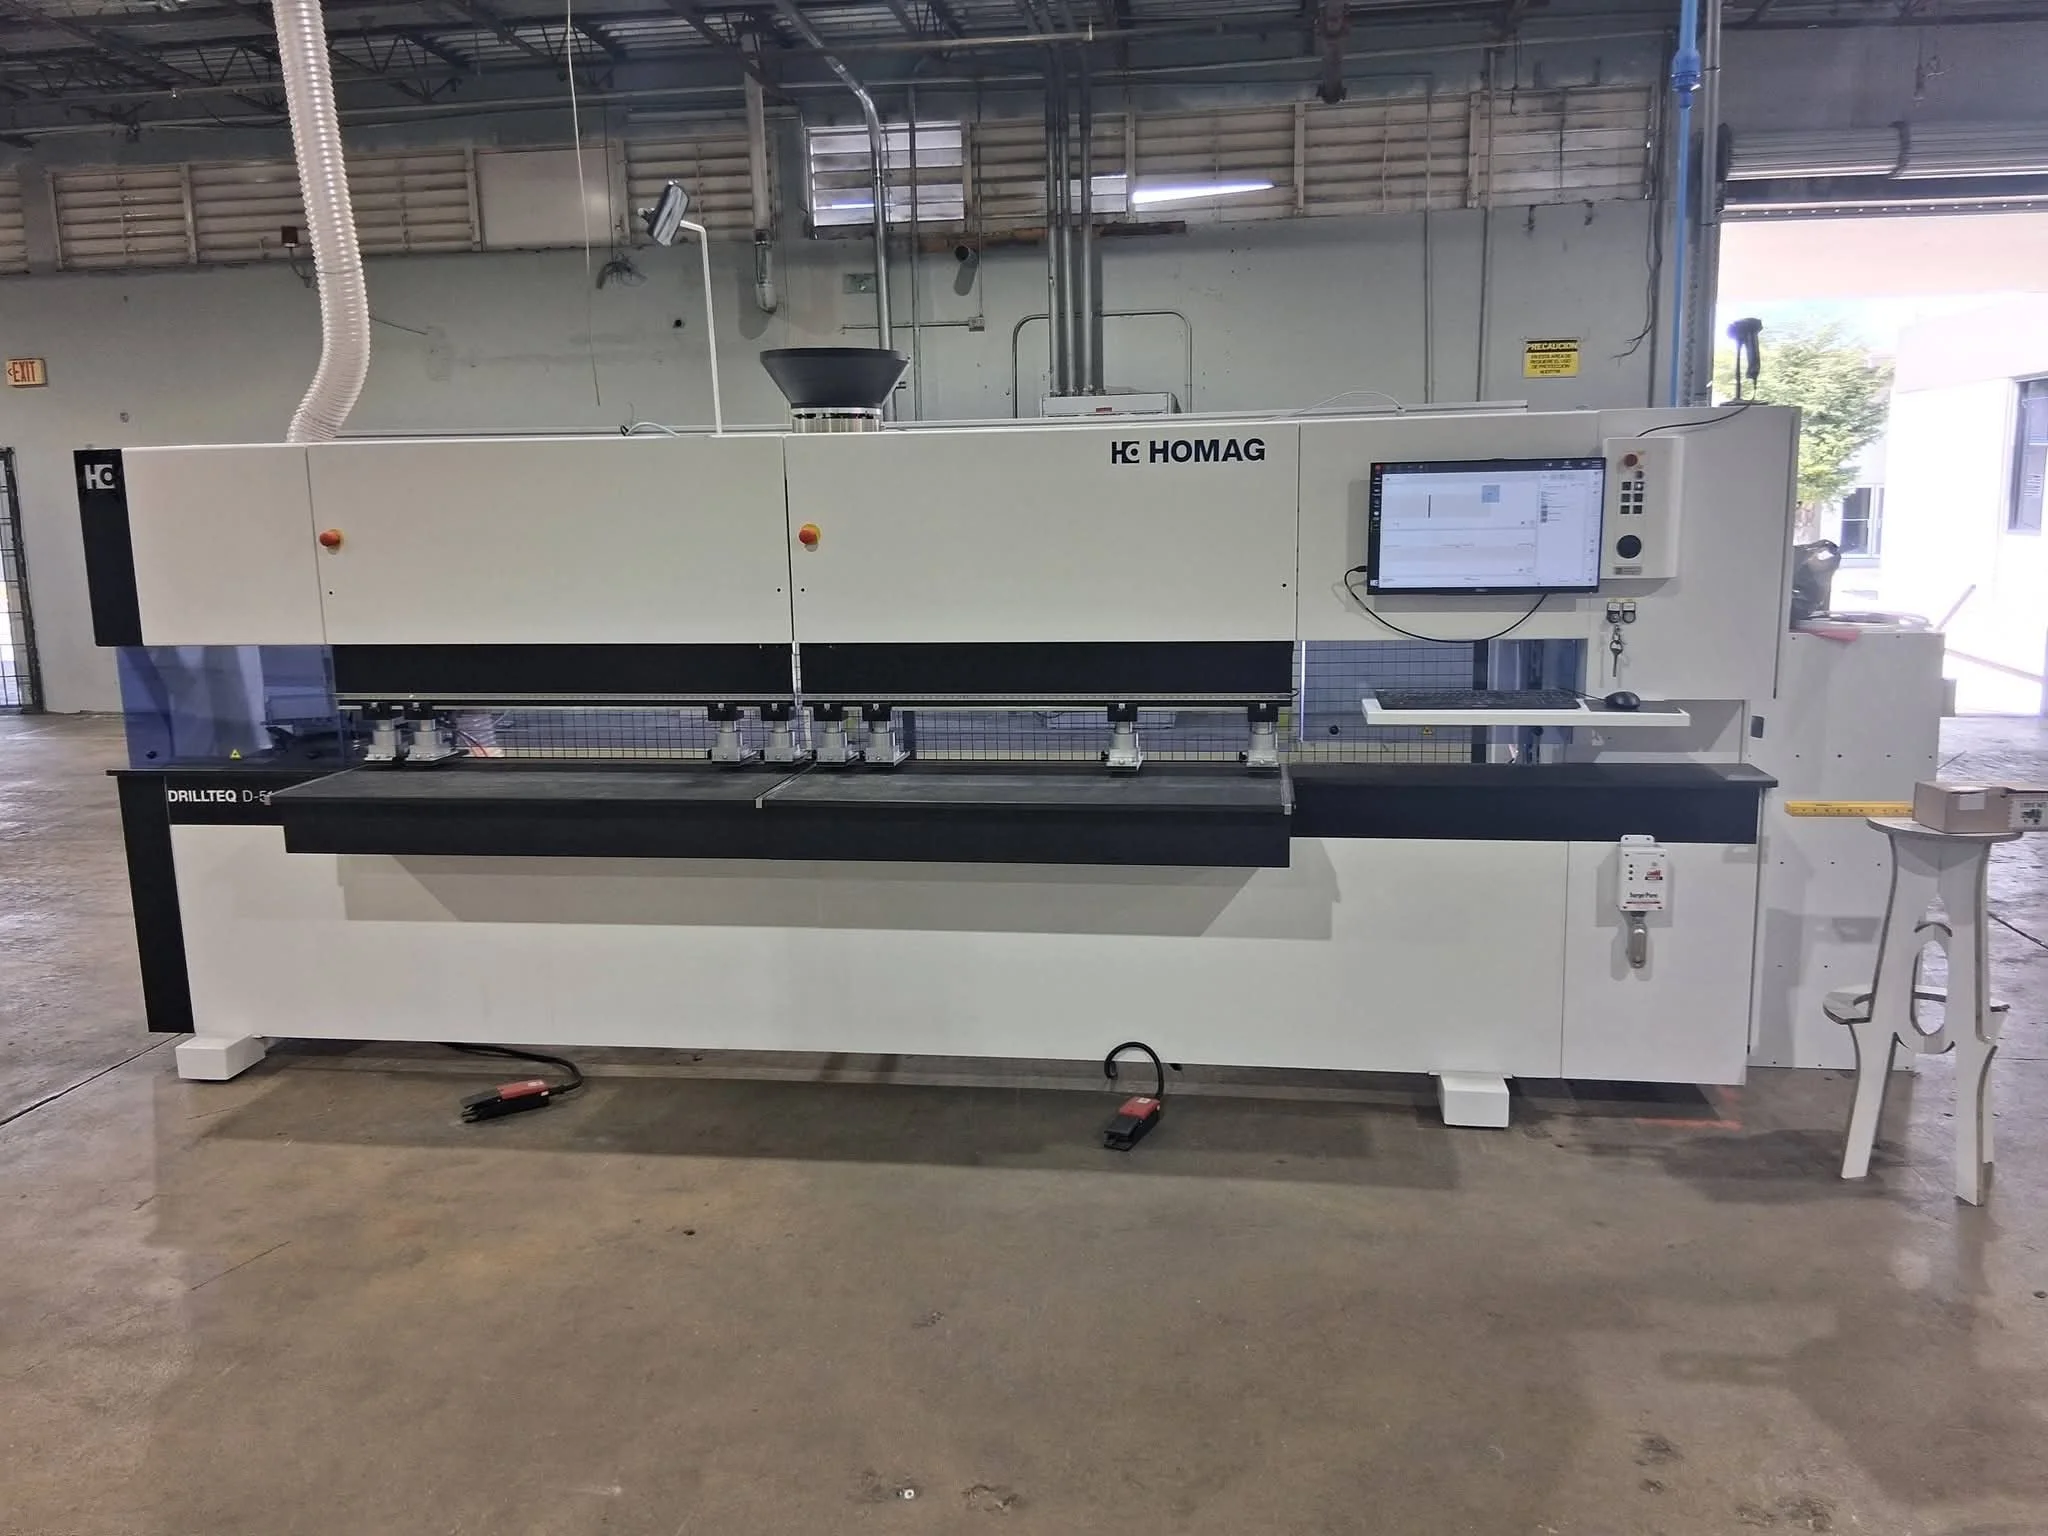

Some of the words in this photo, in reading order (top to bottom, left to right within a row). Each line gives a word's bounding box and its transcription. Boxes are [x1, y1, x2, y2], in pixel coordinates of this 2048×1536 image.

[12, 361, 36, 383] EXIT
[1149, 438, 1266, 464] HOMAG
[167, 790, 237, 802] DRILLTEQ
[242, 791, 272, 802] D-5
